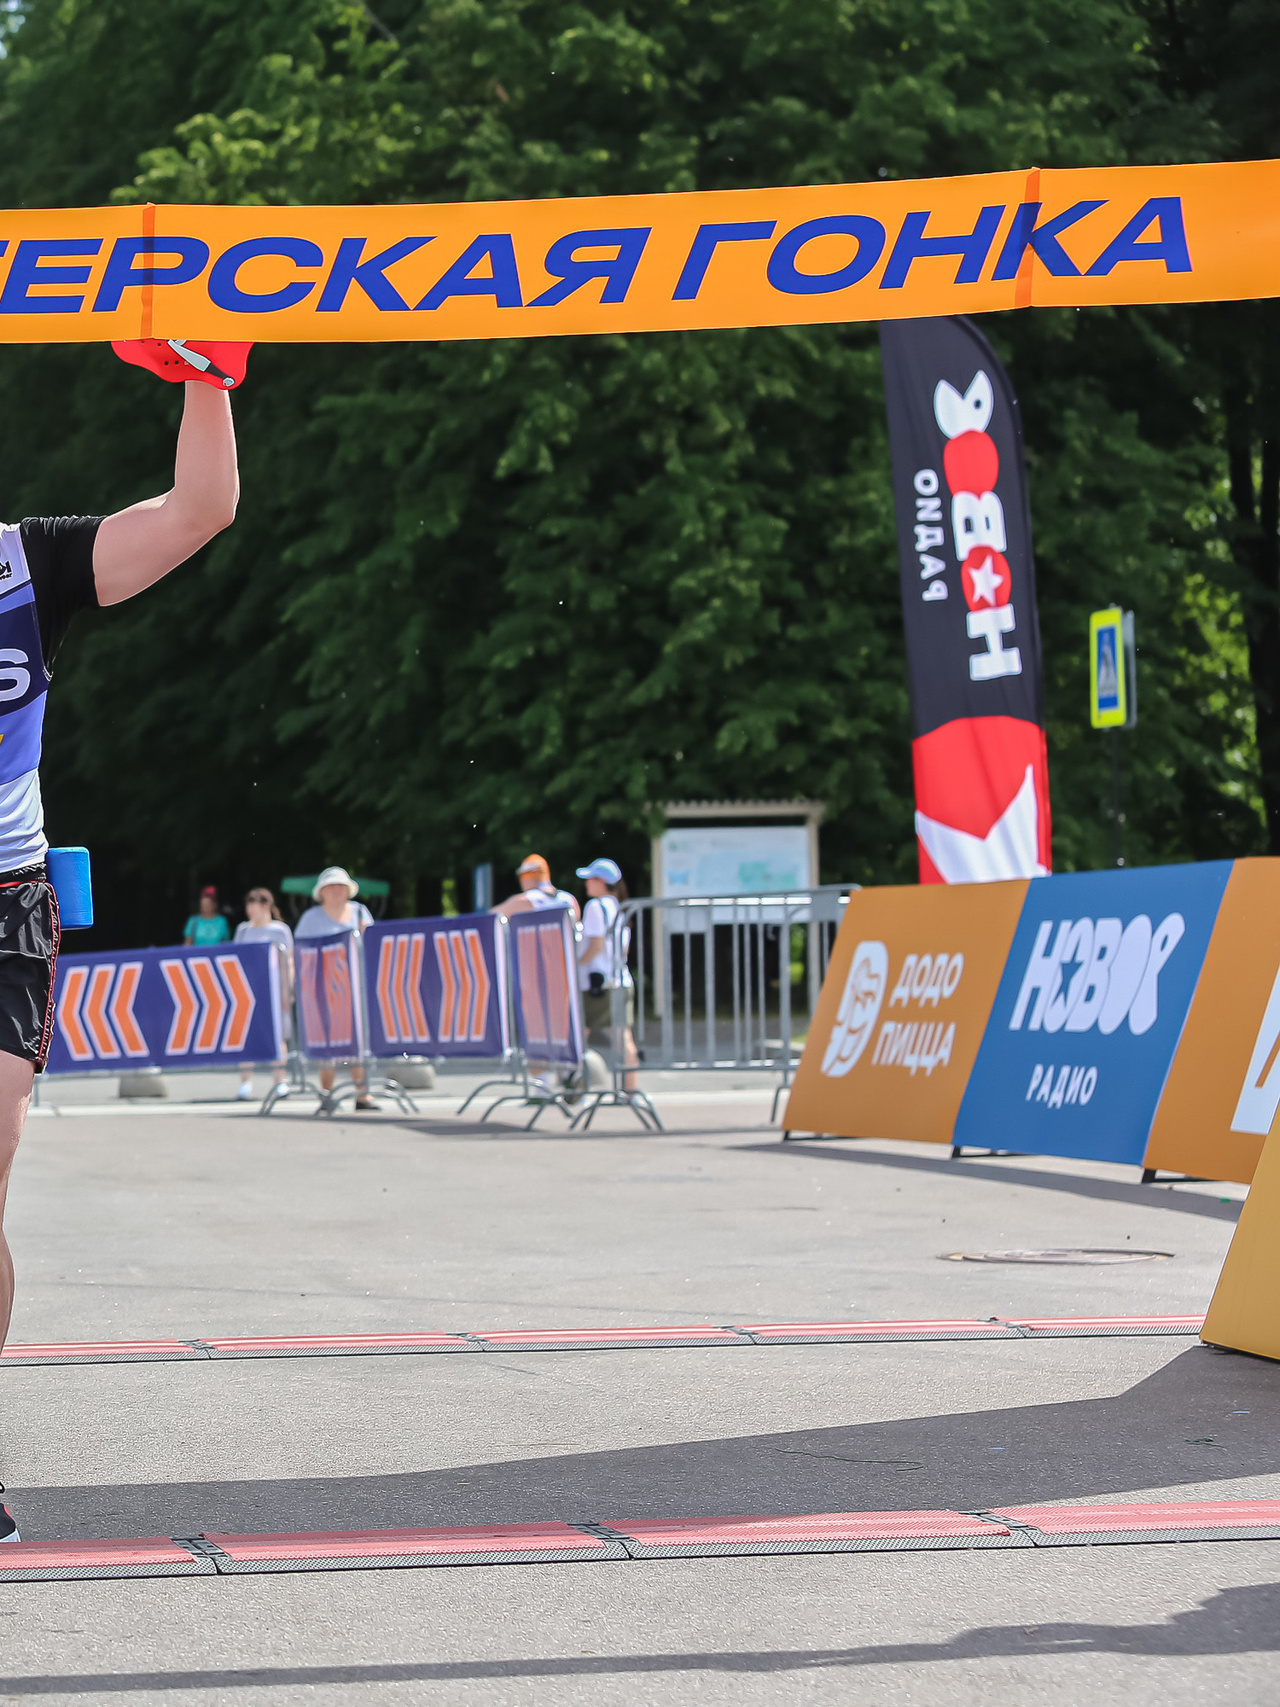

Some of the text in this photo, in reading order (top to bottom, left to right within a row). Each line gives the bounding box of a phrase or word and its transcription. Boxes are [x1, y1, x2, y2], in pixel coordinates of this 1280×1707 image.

[670, 196, 1193, 301] ГОНКА
[889, 952, 965, 1007] ДОДО
[871, 1020, 957, 1076] ПИЦЦА
[1025, 1064, 1099, 1109] РАДИО
